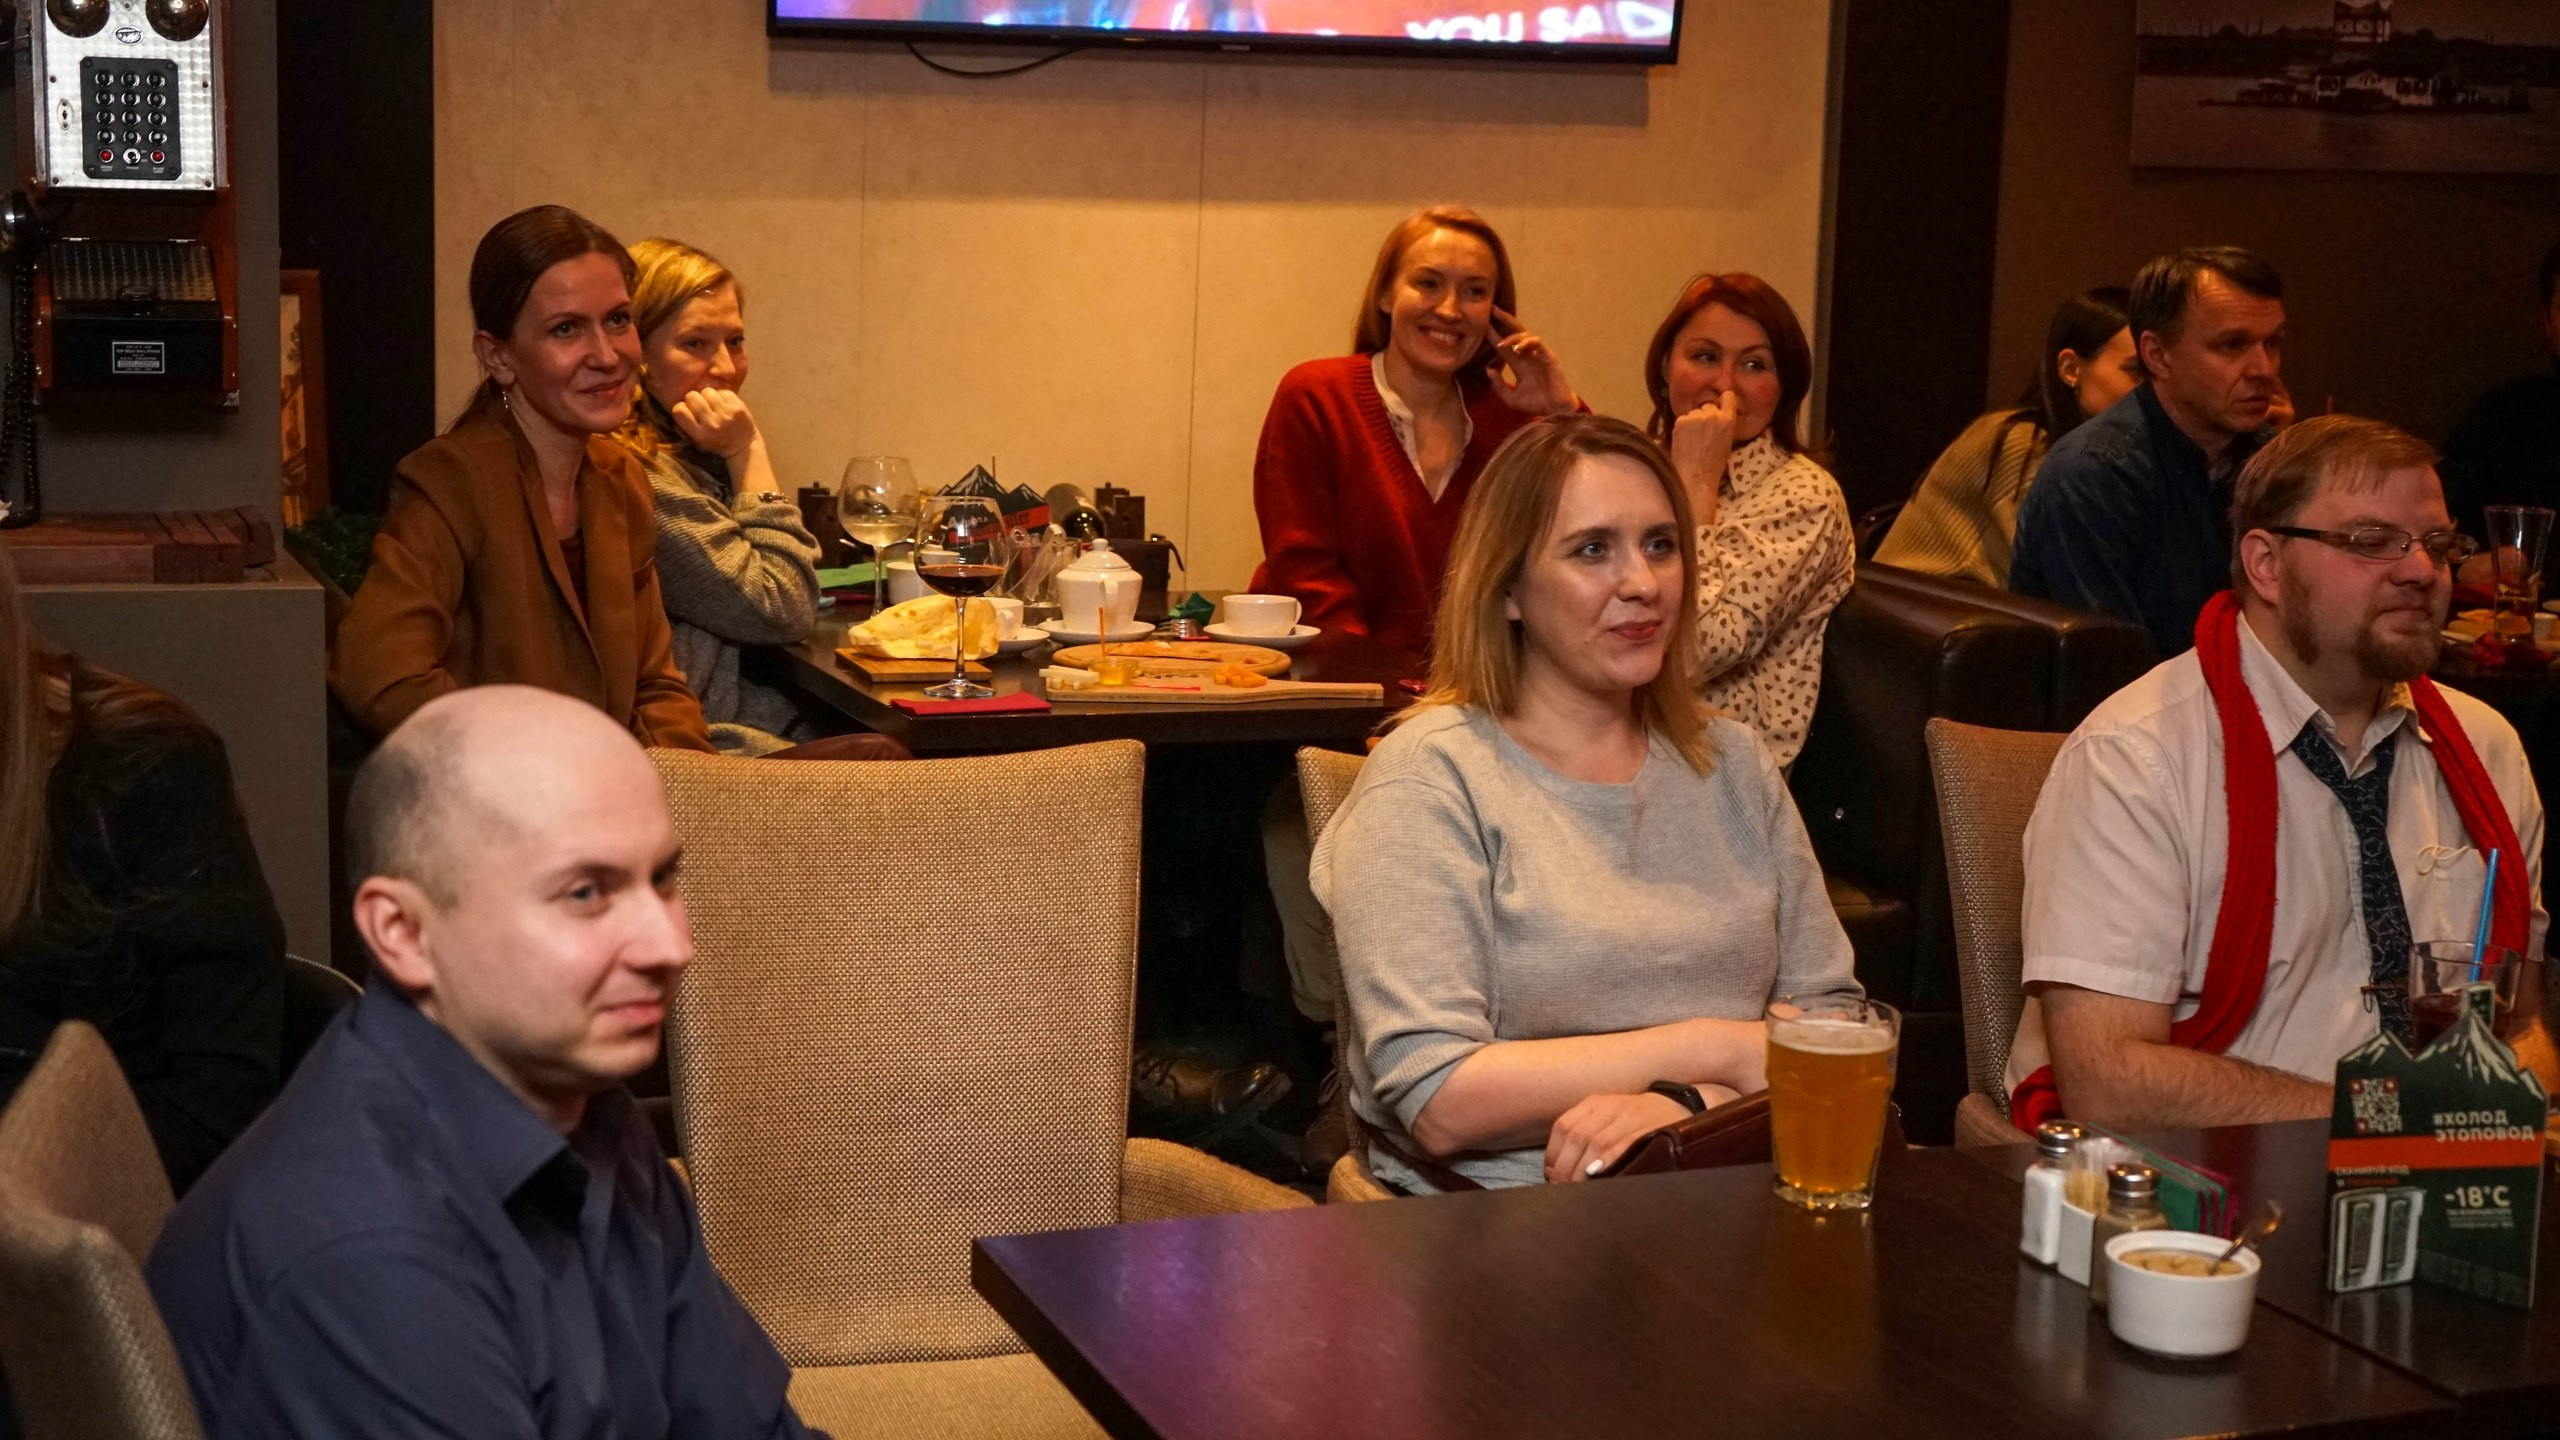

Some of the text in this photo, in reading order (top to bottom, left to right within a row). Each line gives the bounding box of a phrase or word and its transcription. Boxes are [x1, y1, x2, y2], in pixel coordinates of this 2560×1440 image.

[1406, 12, 1524, 42] YOU
[2433, 1109, 2508, 1126] #ХОЛОД
[2434, 1125, 2535, 1142] ЭТОПОВОД
